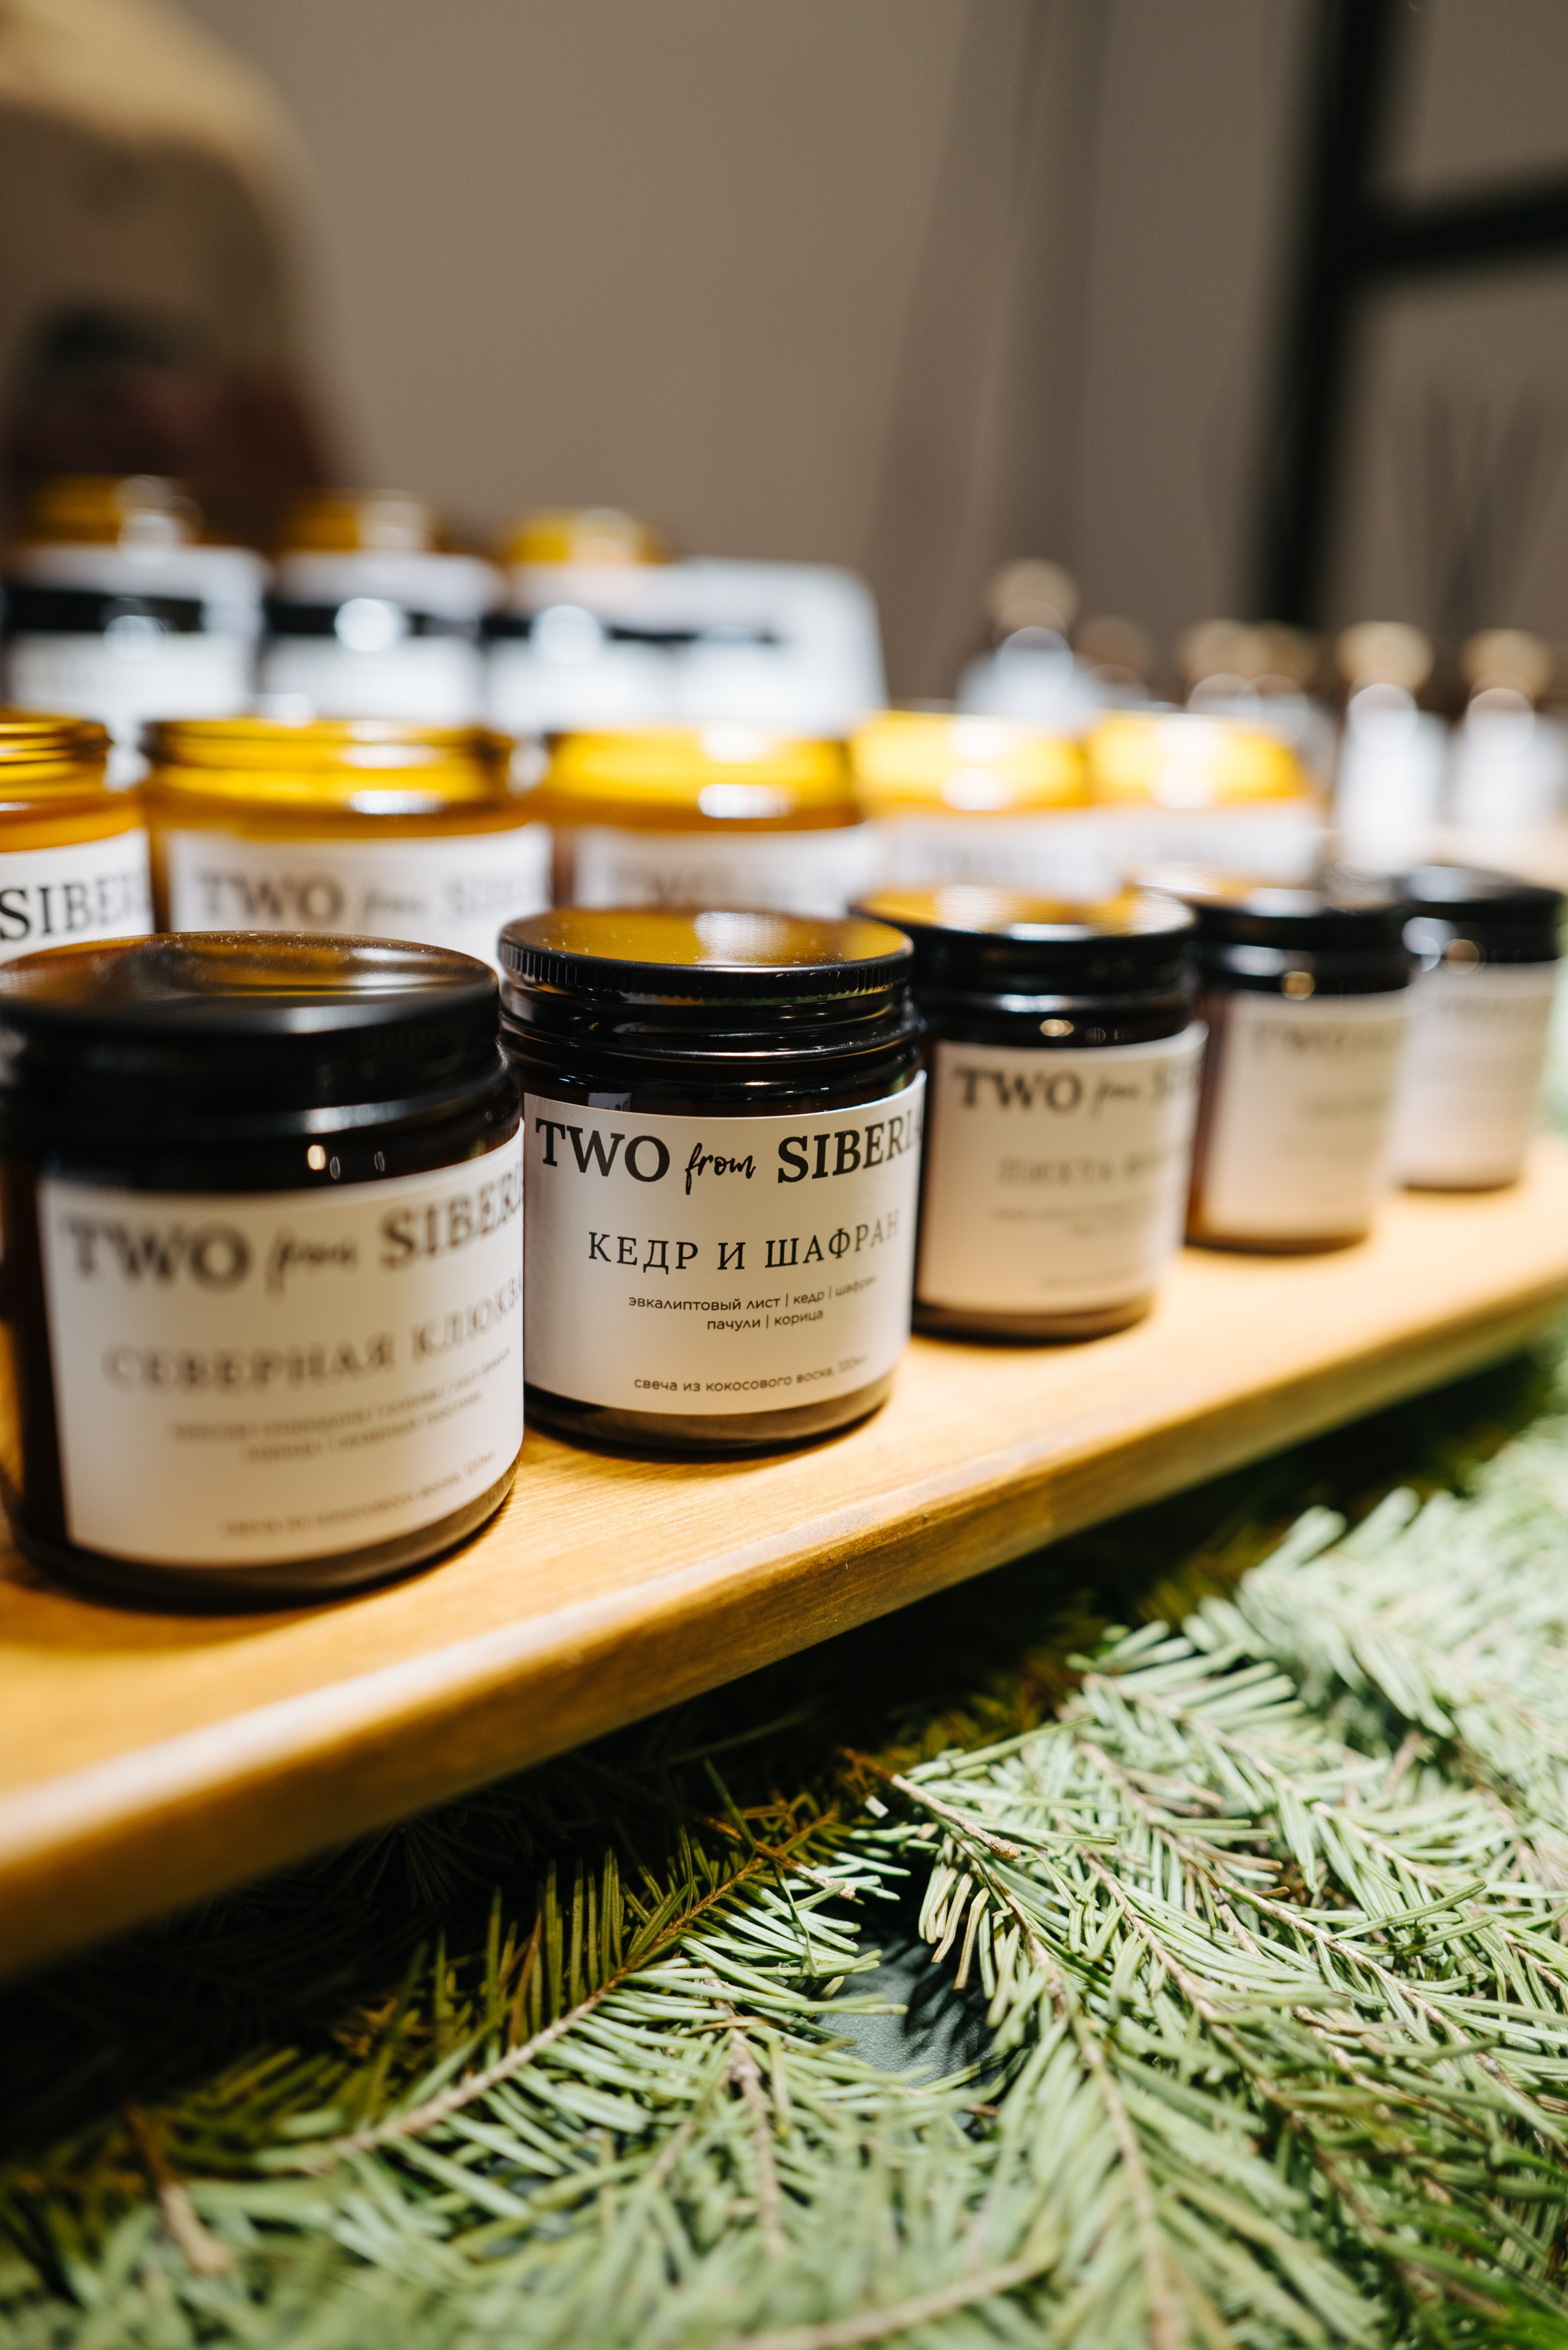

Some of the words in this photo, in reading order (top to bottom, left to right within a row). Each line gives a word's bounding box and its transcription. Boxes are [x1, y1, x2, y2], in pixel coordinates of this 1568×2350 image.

[196, 871, 345, 927] TWO
[953, 1065, 1085, 1115] TWO
[536, 1117, 670, 1182] TWO
[685, 1142, 756, 1194] from
[66, 1217, 254, 1293] TWO
[378, 1160, 524, 1269] SIBERI
[588, 1231, 698, 1275] КЕДР
[717, 1242, 745, 1270] И
[765, 1208, 901, 1268] ШАФРАН
[410, 1267, 524, 1366] КЛЮКВ
[628, 1297, 741, 1311] эвкалиптовый
[746, 1296, 781, 1310] лист
[793, 1288, 825, 1306] кедр
[707, 1318, 761, 1331] пачули
[774, 1309, 824, 1327] корица
[634, 1378, 678, 1392] свеча
[683, 1382, 701, 1392] из
[706, 1375, 793, 1392] кокосового
